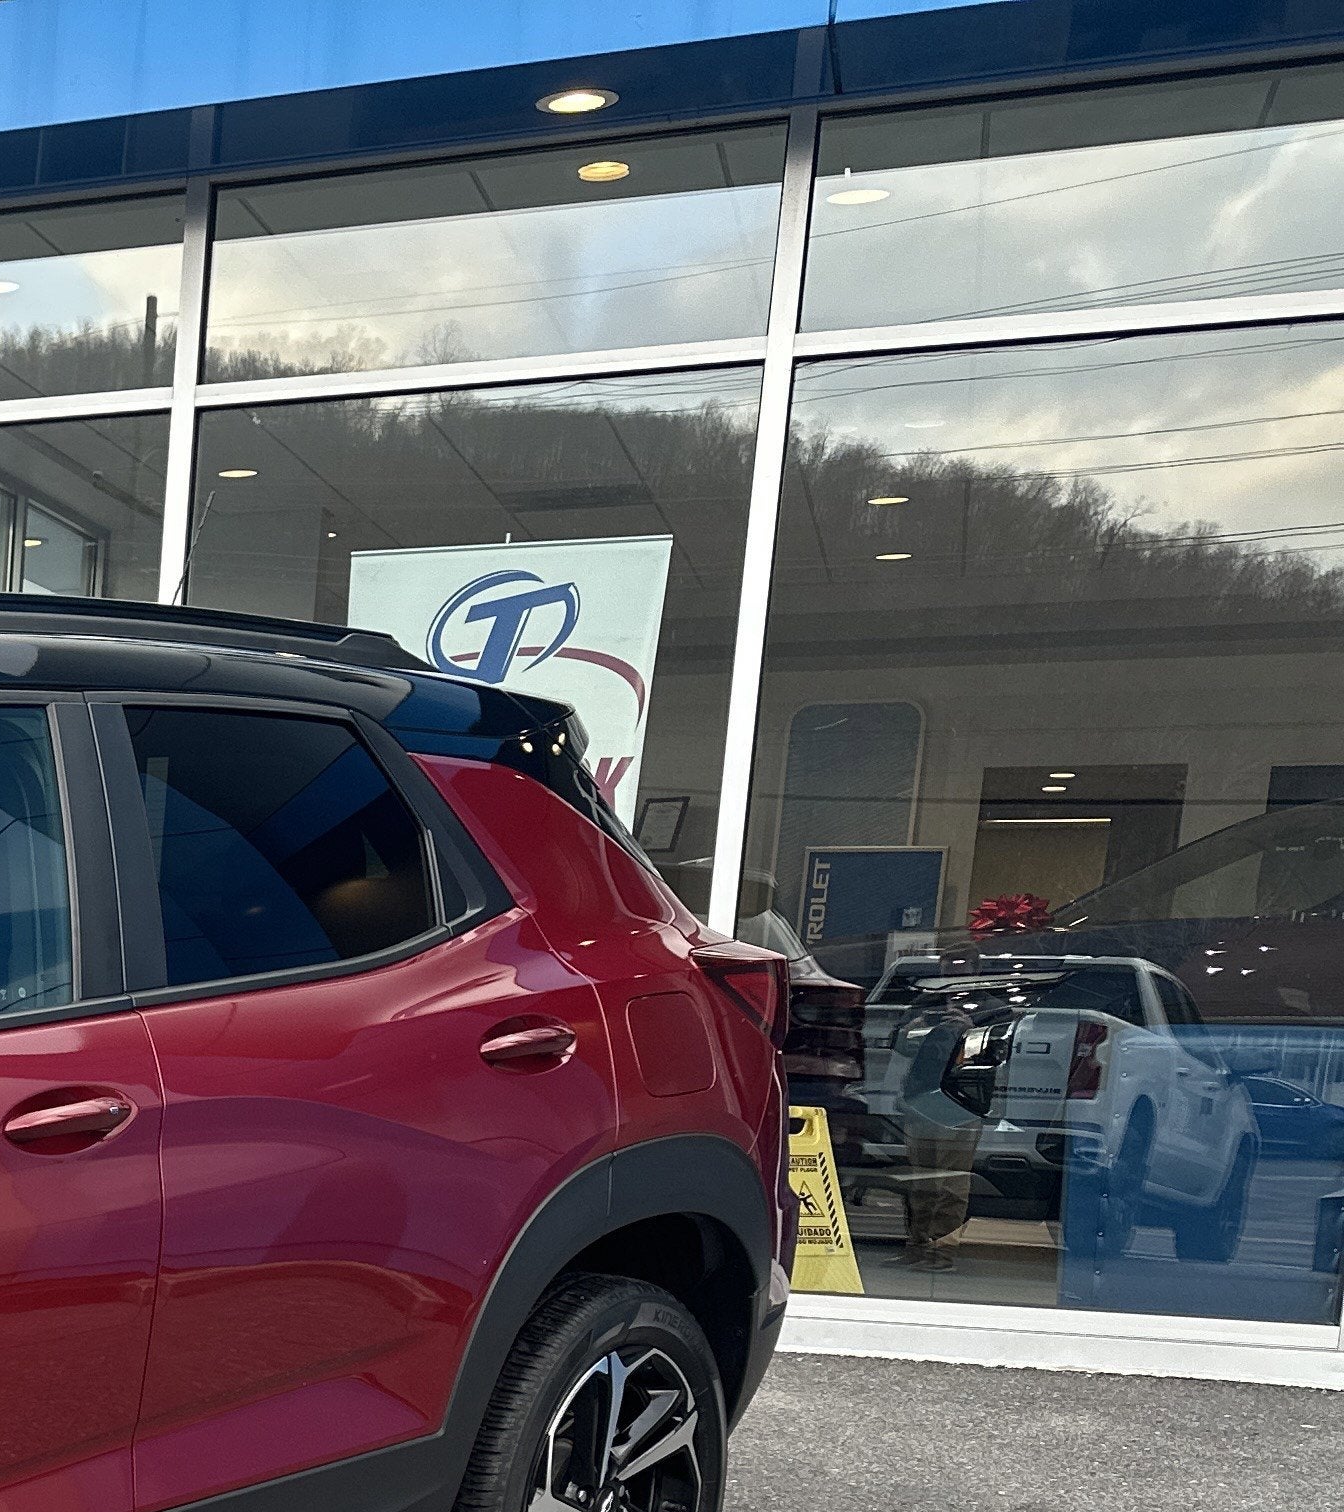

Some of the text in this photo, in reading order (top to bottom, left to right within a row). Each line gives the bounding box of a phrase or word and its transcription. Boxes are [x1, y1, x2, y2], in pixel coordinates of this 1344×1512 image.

[806, 858, 831, 944] ROLET
[790, 1157, 818, 1165] AUTION
[799, 1228, 831, 1236] UIDADO
